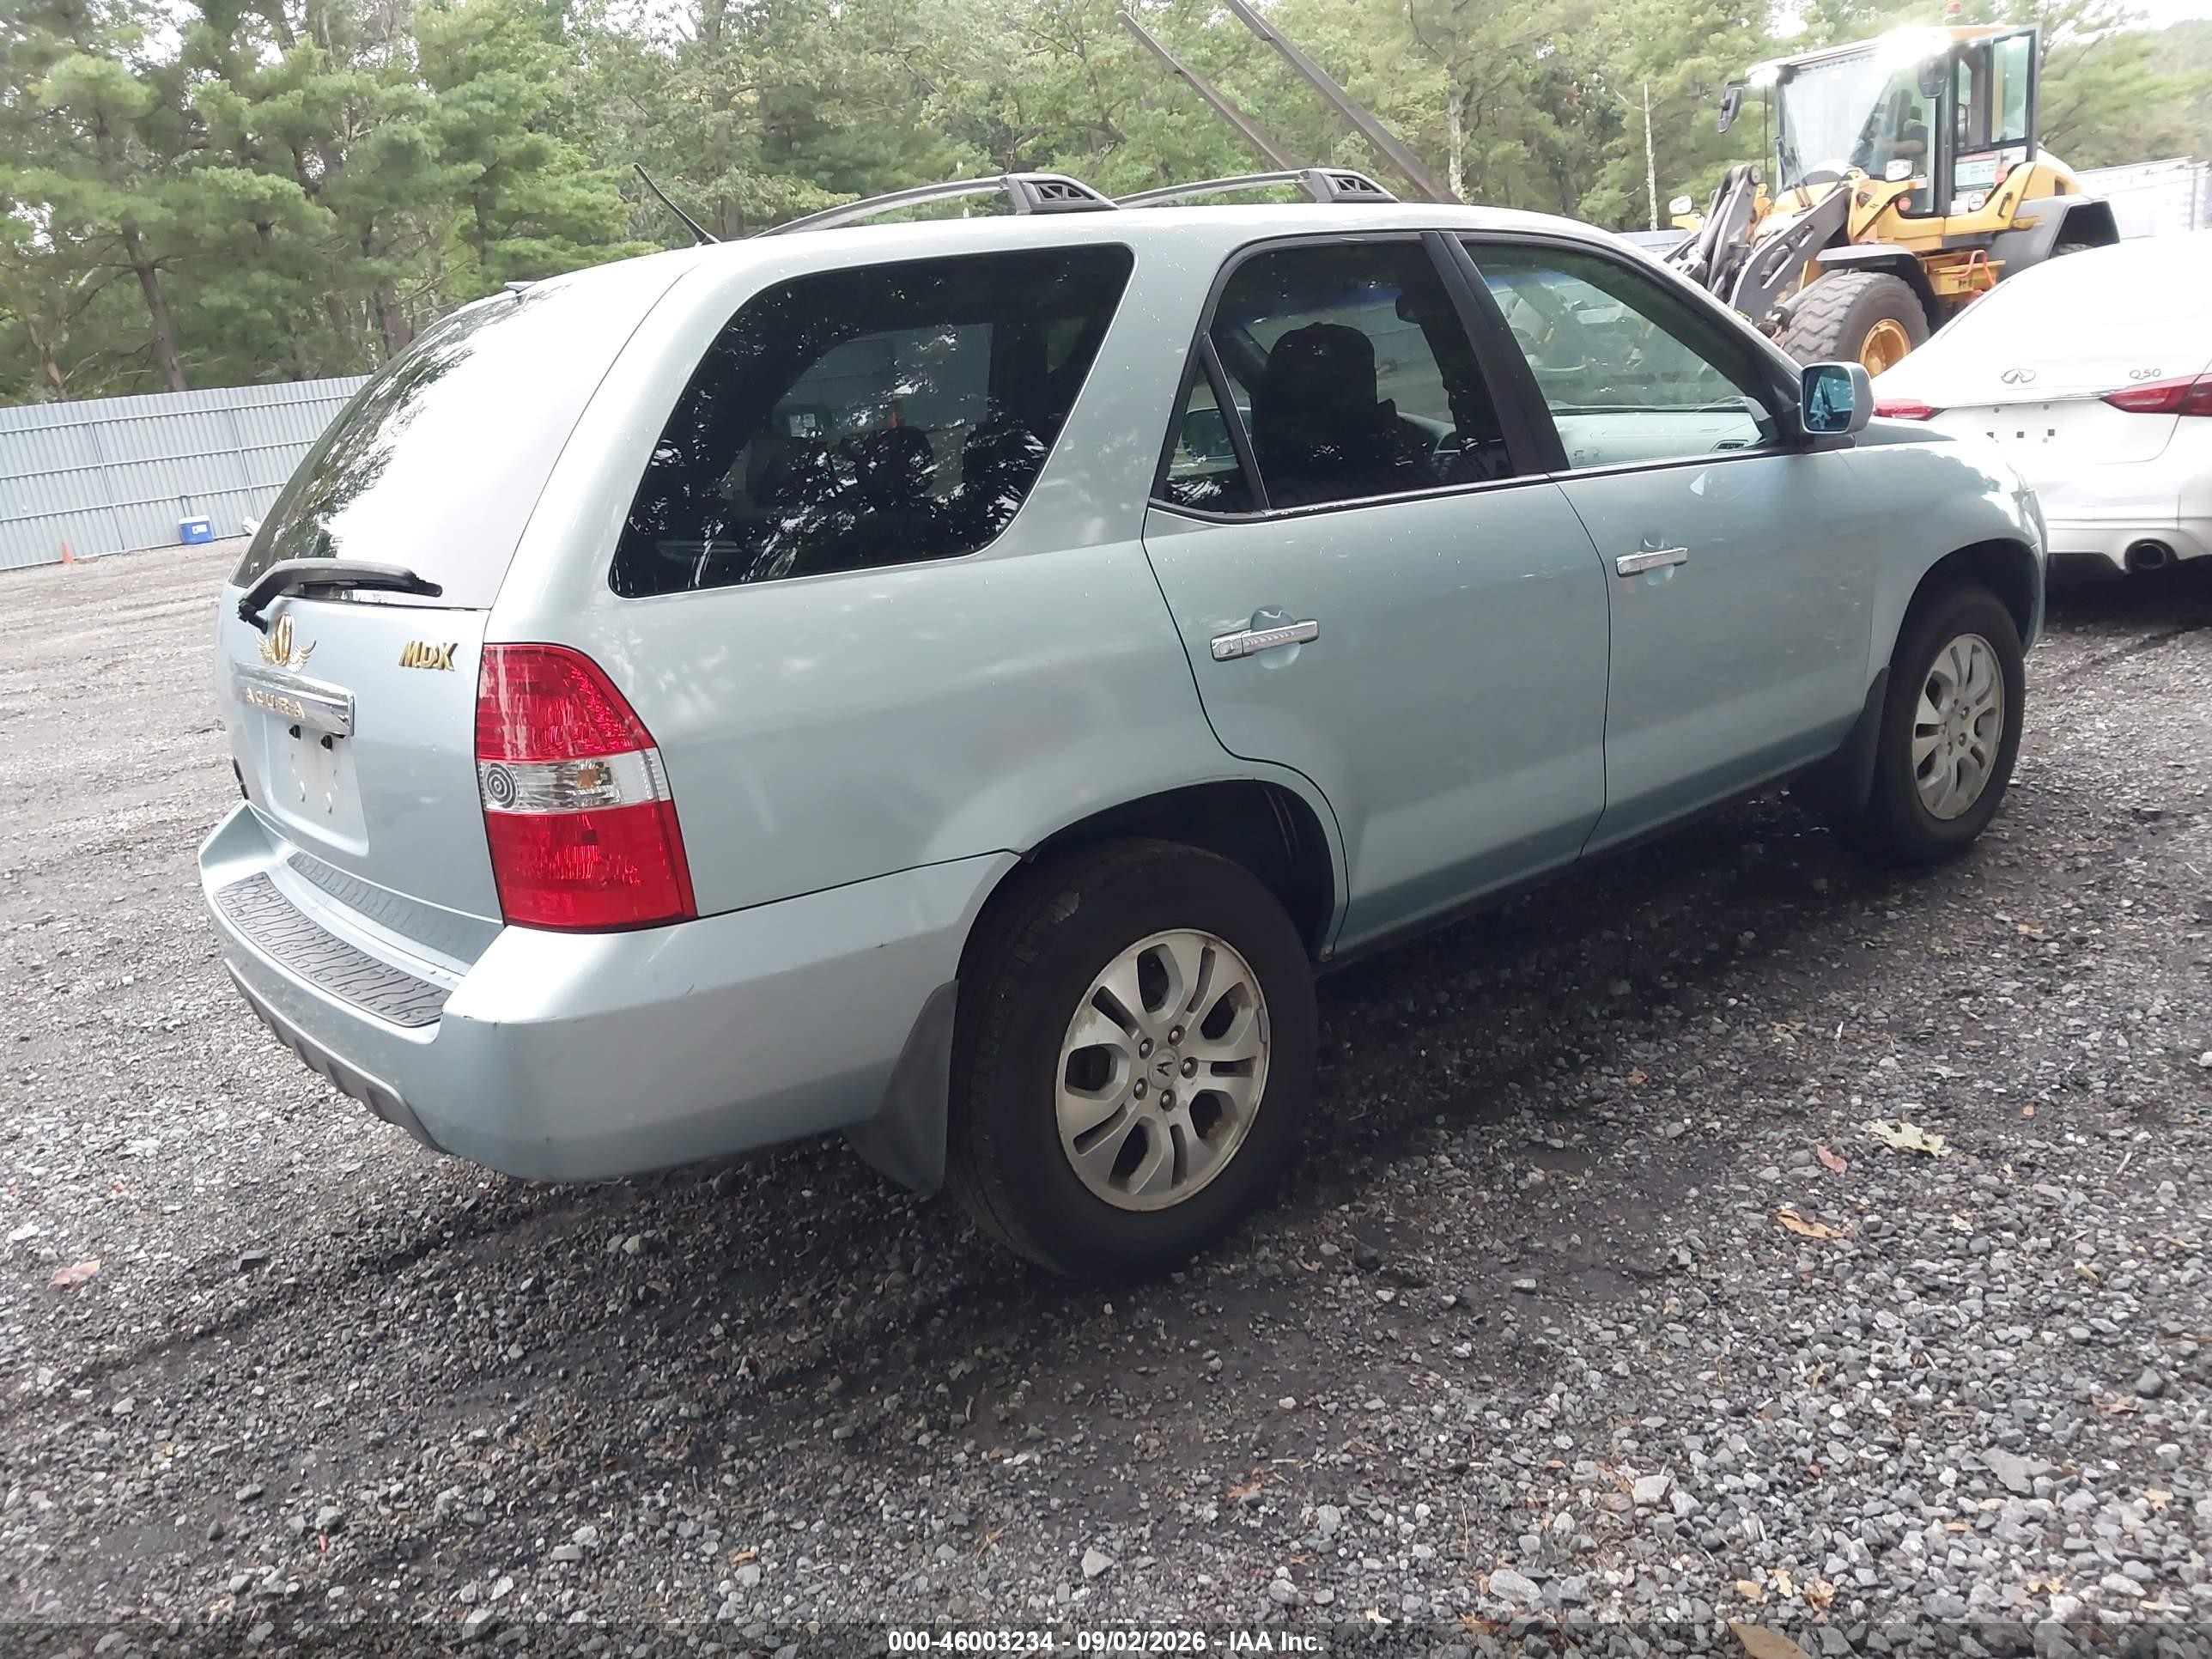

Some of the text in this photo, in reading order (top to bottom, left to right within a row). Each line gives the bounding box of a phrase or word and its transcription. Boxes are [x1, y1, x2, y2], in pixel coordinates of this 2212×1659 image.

[2130, 368, 2161, 380] Q50
[398, 640, 458, 672] MDX
[246, 687, 306, 719] ACURA
